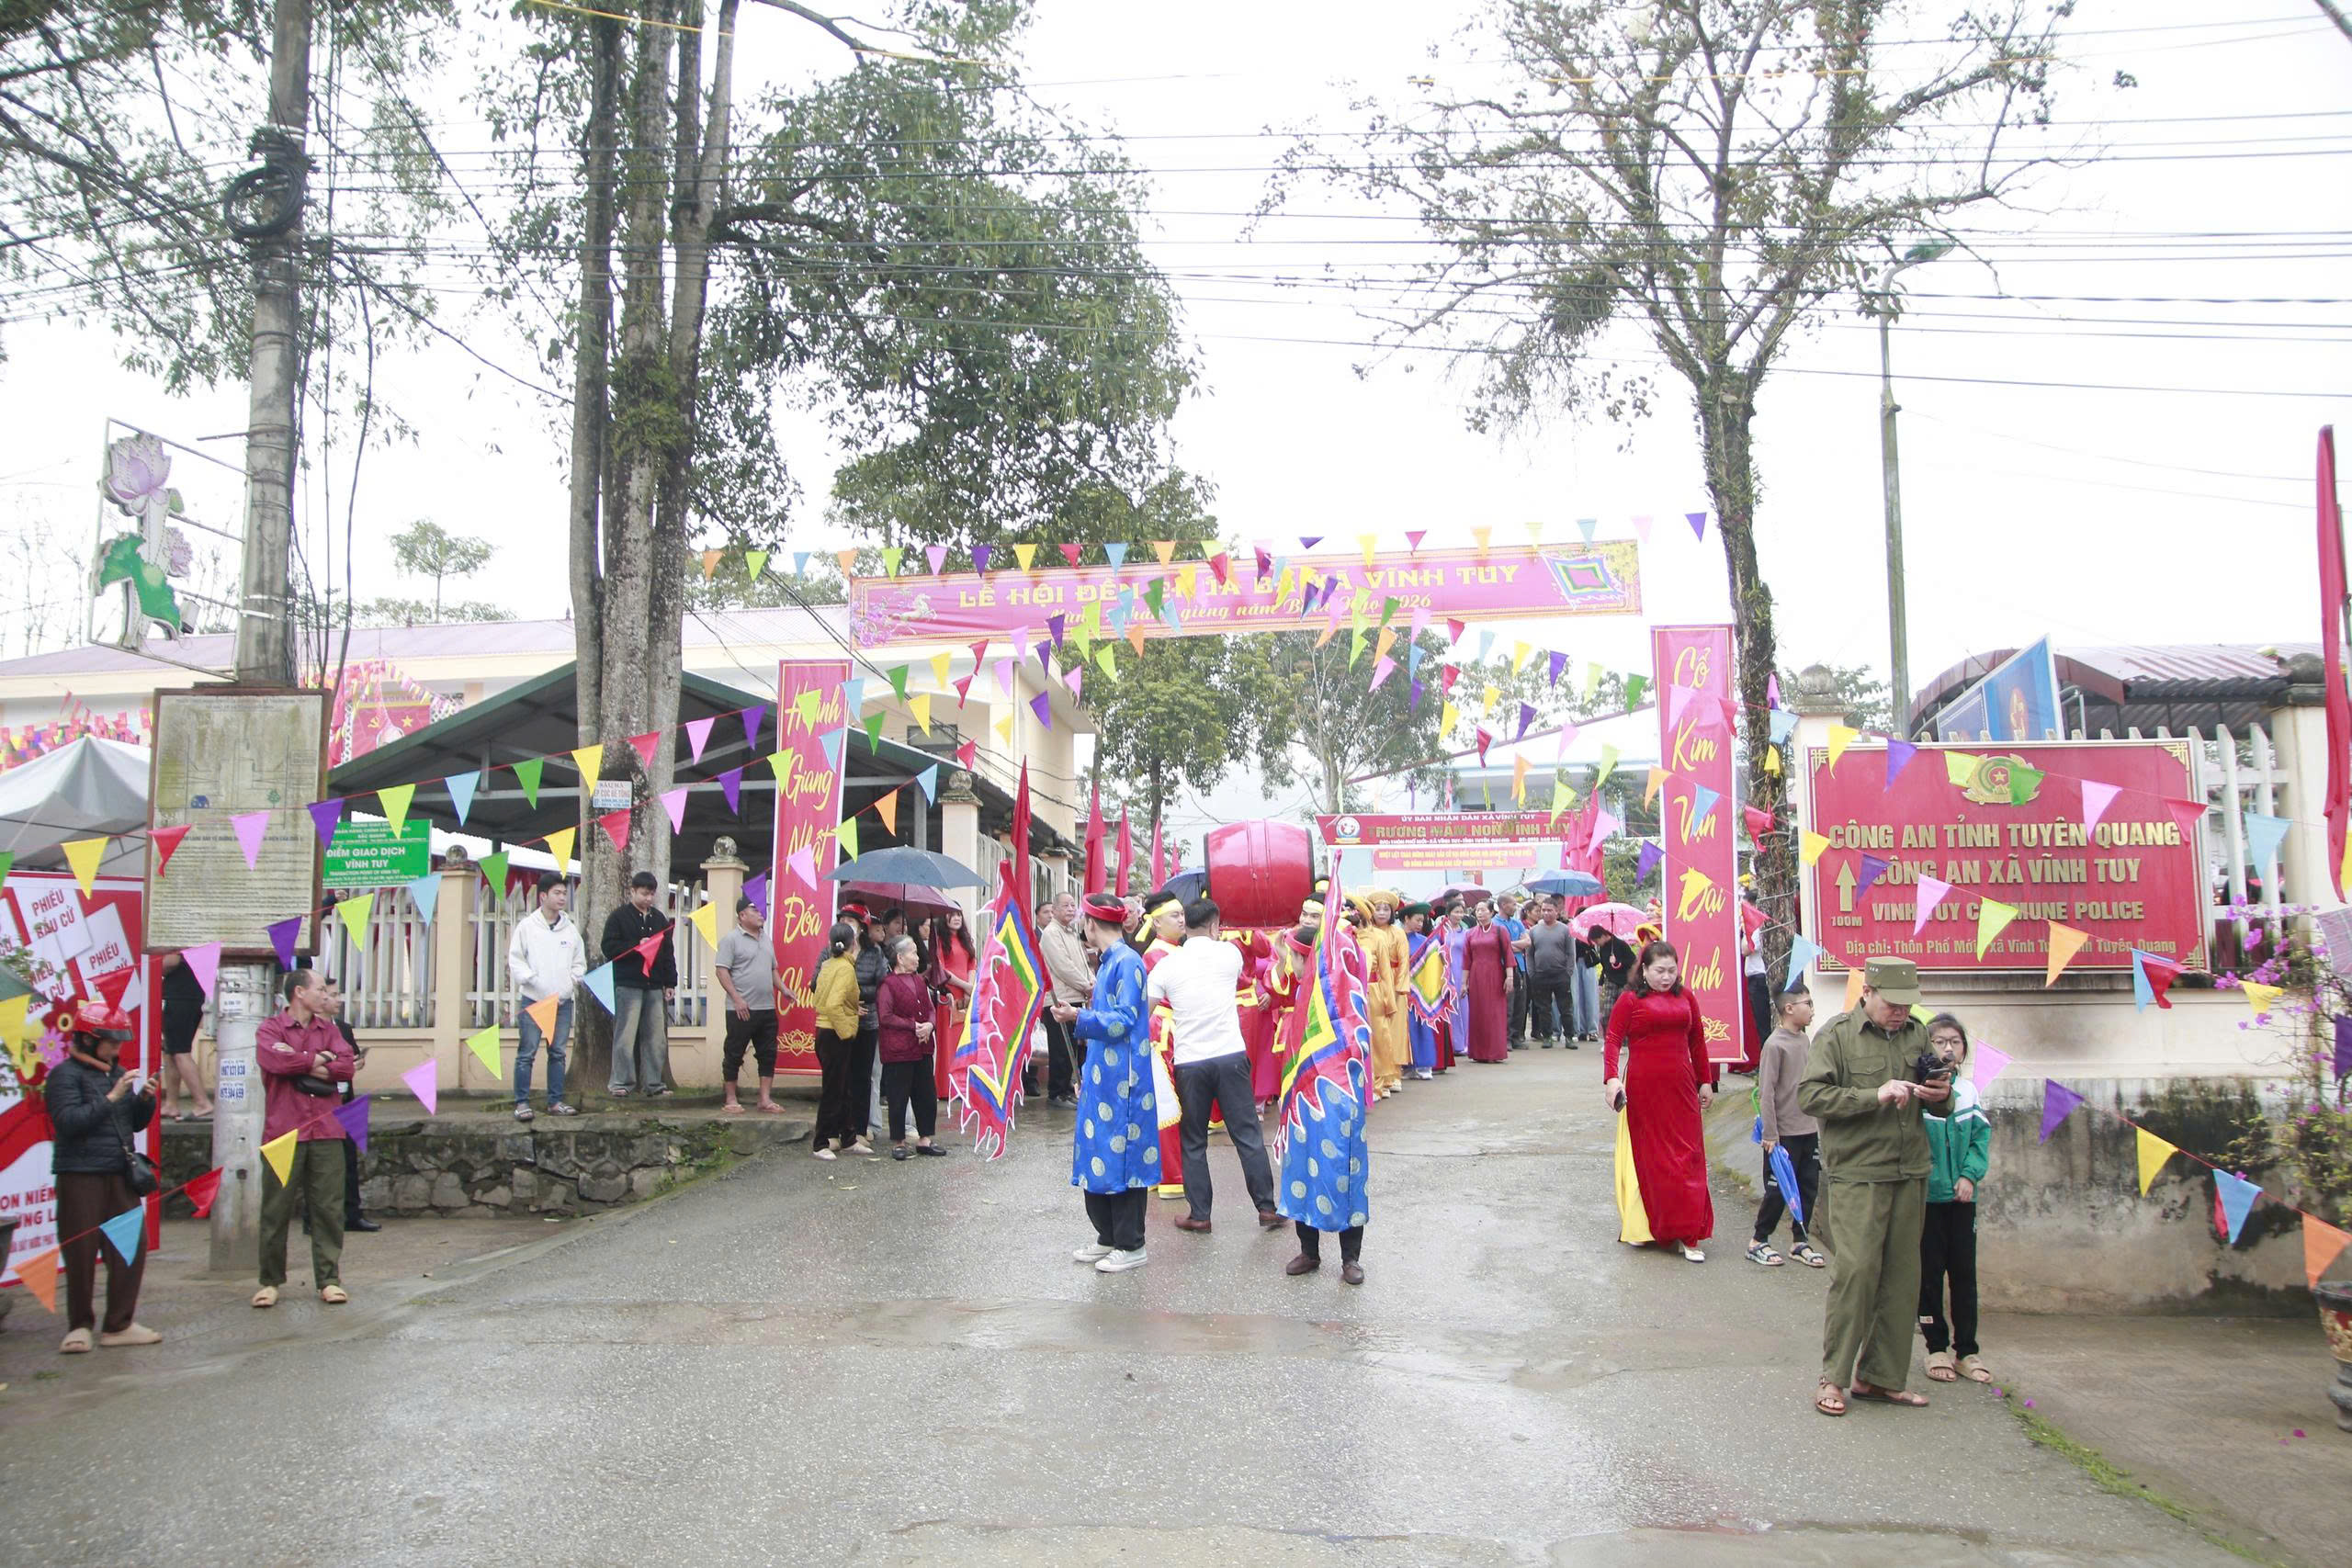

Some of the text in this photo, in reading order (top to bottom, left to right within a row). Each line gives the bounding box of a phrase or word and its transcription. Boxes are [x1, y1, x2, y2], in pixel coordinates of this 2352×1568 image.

[1006, 582, 1064, 607] HỘI
[1365, 567, 1445, 589] VĨNH
[1455, 564, 1521, 585] TUY
[1387, 593, 1431, 608] 026
[1670, 716, 1720, 772] Kim
[786, 753, 834, 811] Giang
[1828, 814, 2181, 849] CÔNG AN TỈNH TUYÊN QUANG
[326, 845, 405, 859] ĐIỂM GIAO DỊCH
[345, 859, 389, 869] VĨNH TUY
[1945, 860, 1981, 885] AN
[1987, 853, 2024, 885] XÃ
[2027, 853, 2087, 884] VĨNH
[2094, 858, 2142, 883] TUY
[783, 891, 822, 944] Đóa
[1871, 901, 2145, 921] VINH UY CMUNE POLICE
[1845, 940, 1866, 956] Địa
[1894, 938, 1923, 954] Thôn
[1926, 936, 1951, 953] Phố
[1990, 939, 2004, 953] xã
[2038, 939, 2050, 953] Tu
[2096, 938, 2132, 955] Tuyên
[2137, 939, 2177, 954] Quang
